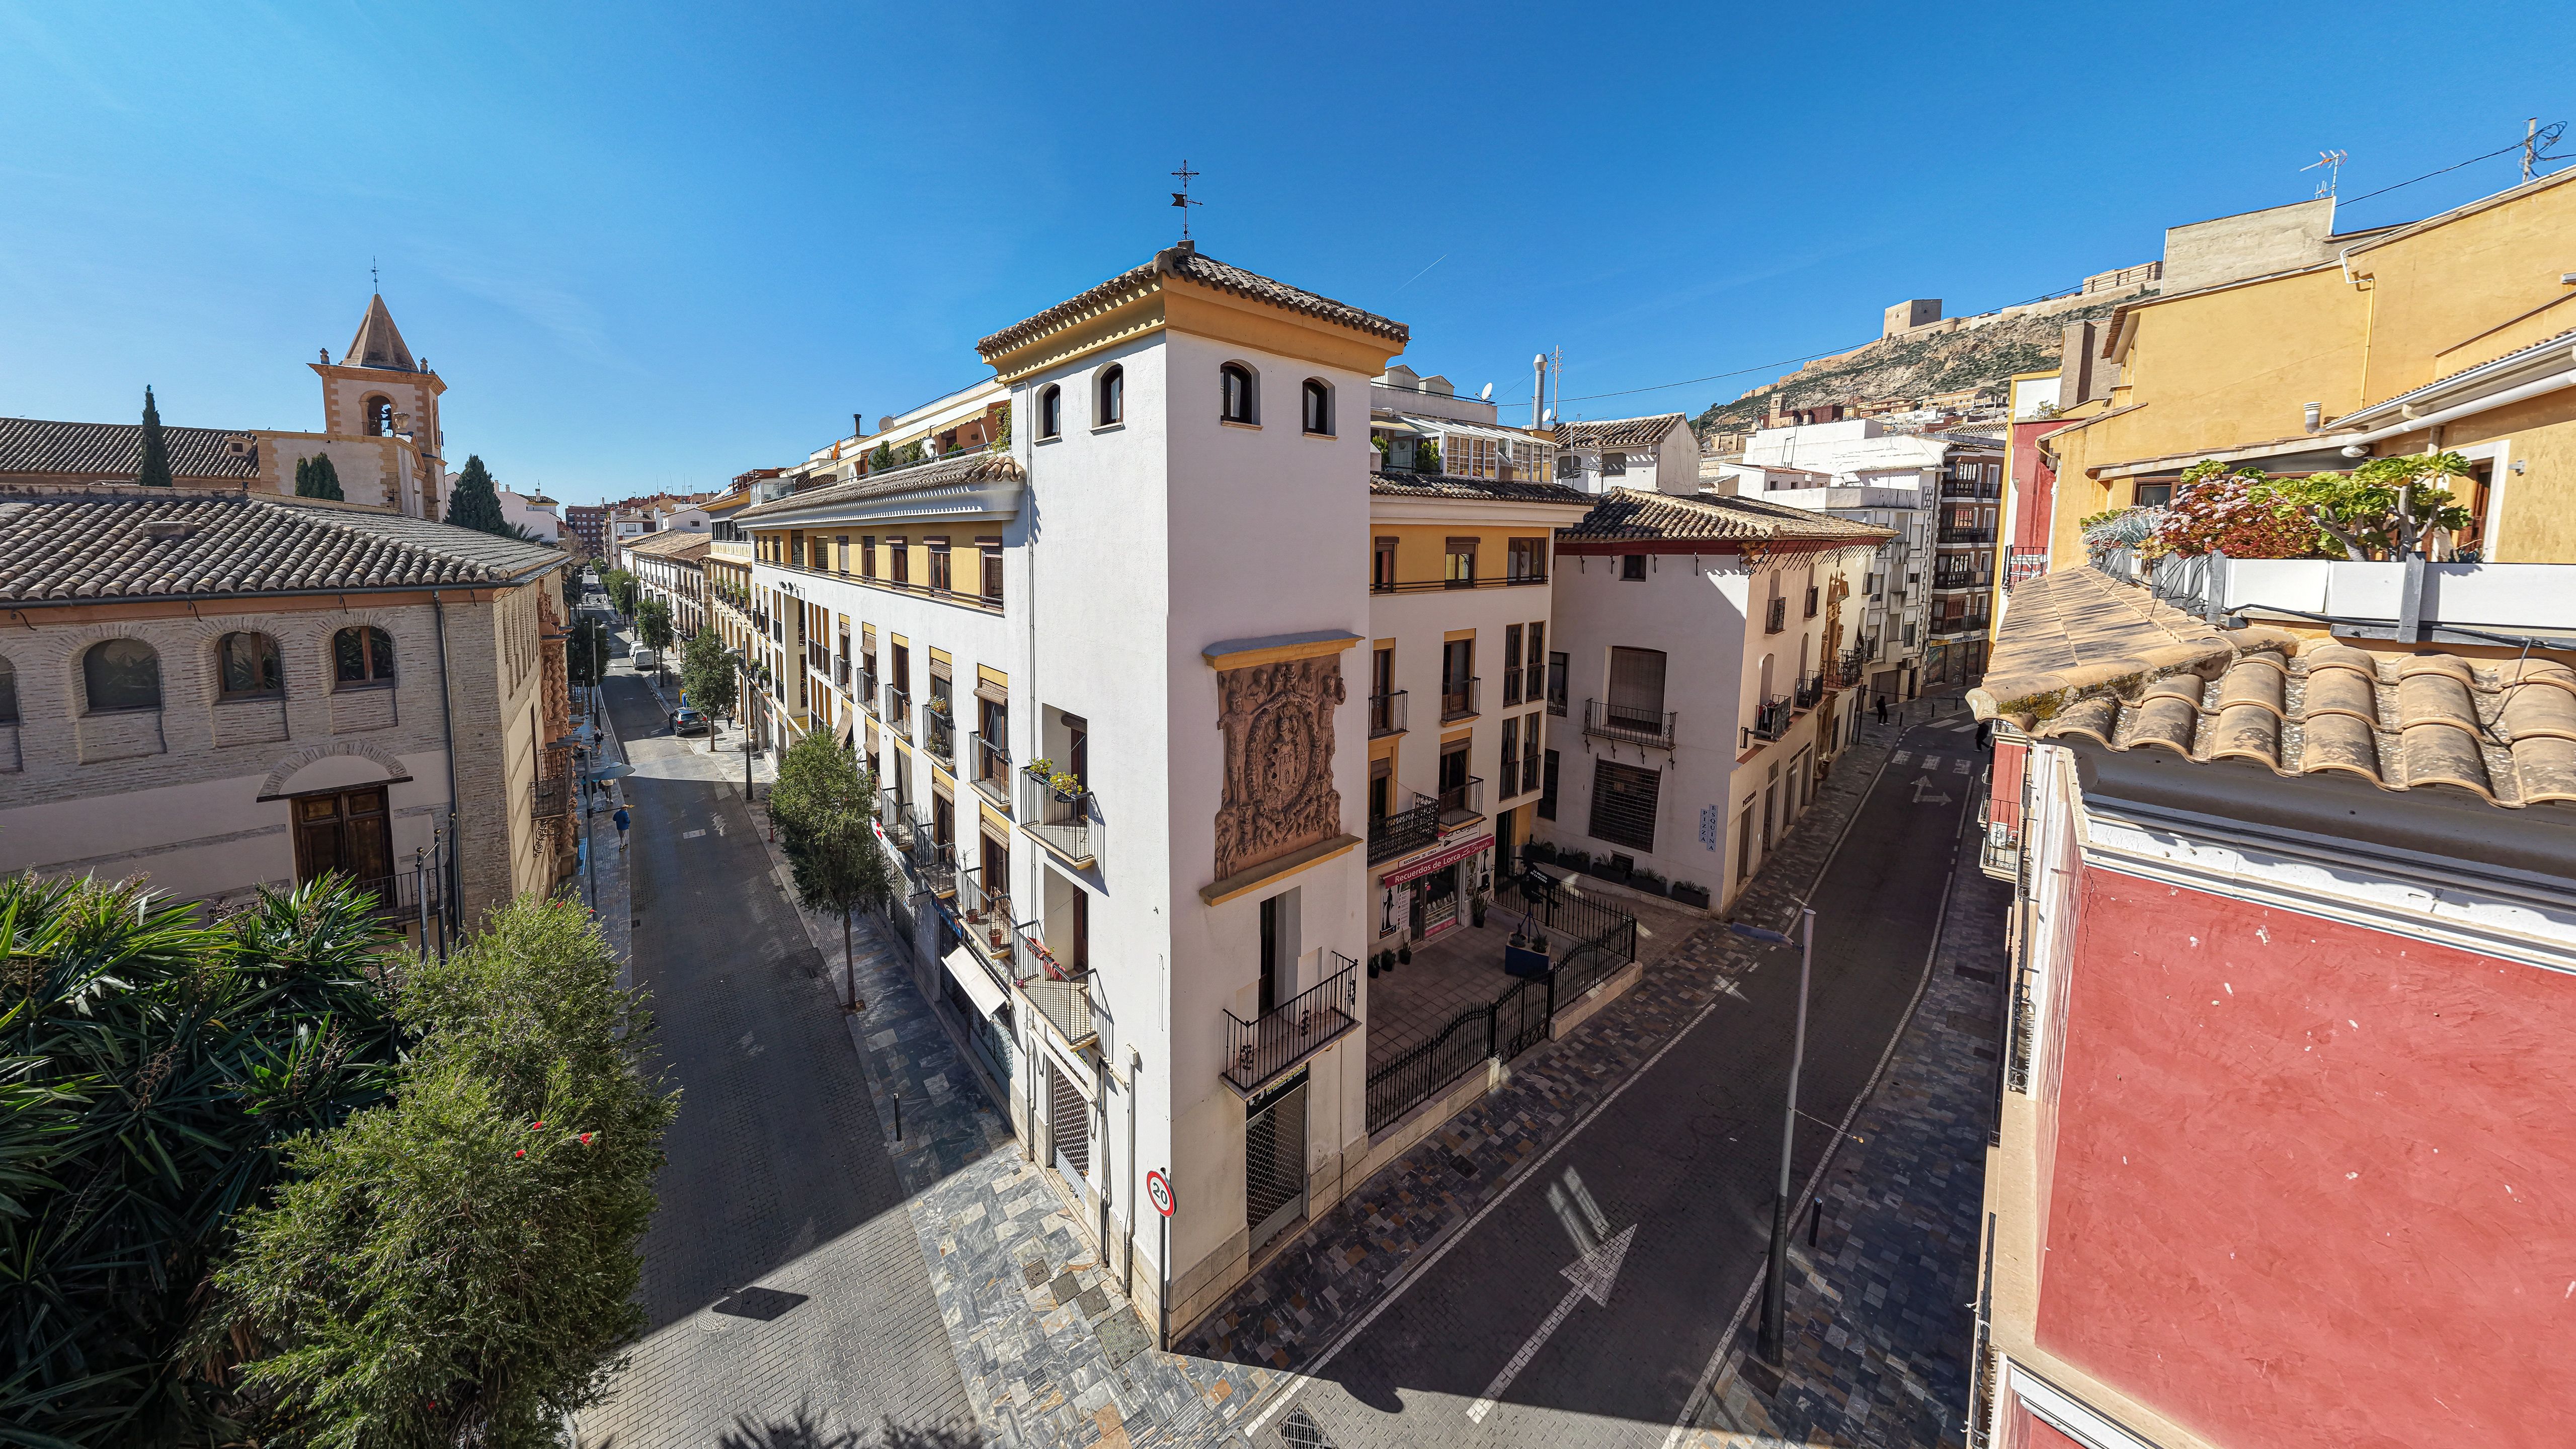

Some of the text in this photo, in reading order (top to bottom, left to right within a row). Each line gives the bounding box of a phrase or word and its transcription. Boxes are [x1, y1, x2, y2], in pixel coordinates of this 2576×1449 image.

[1395, 864, 1431, 883] Recuerdos
[1433, 861, 1441, 869] de
[1443, 853, 1460, 864] Lorca
[1403, 855, 1420, 865] RECUERDOS
[1272, 1081, 1287, 1092] TIENDA
[1294, 1067, 1306, 1078] VAPEO
[1153, 1182, 1168, 1205] 20
